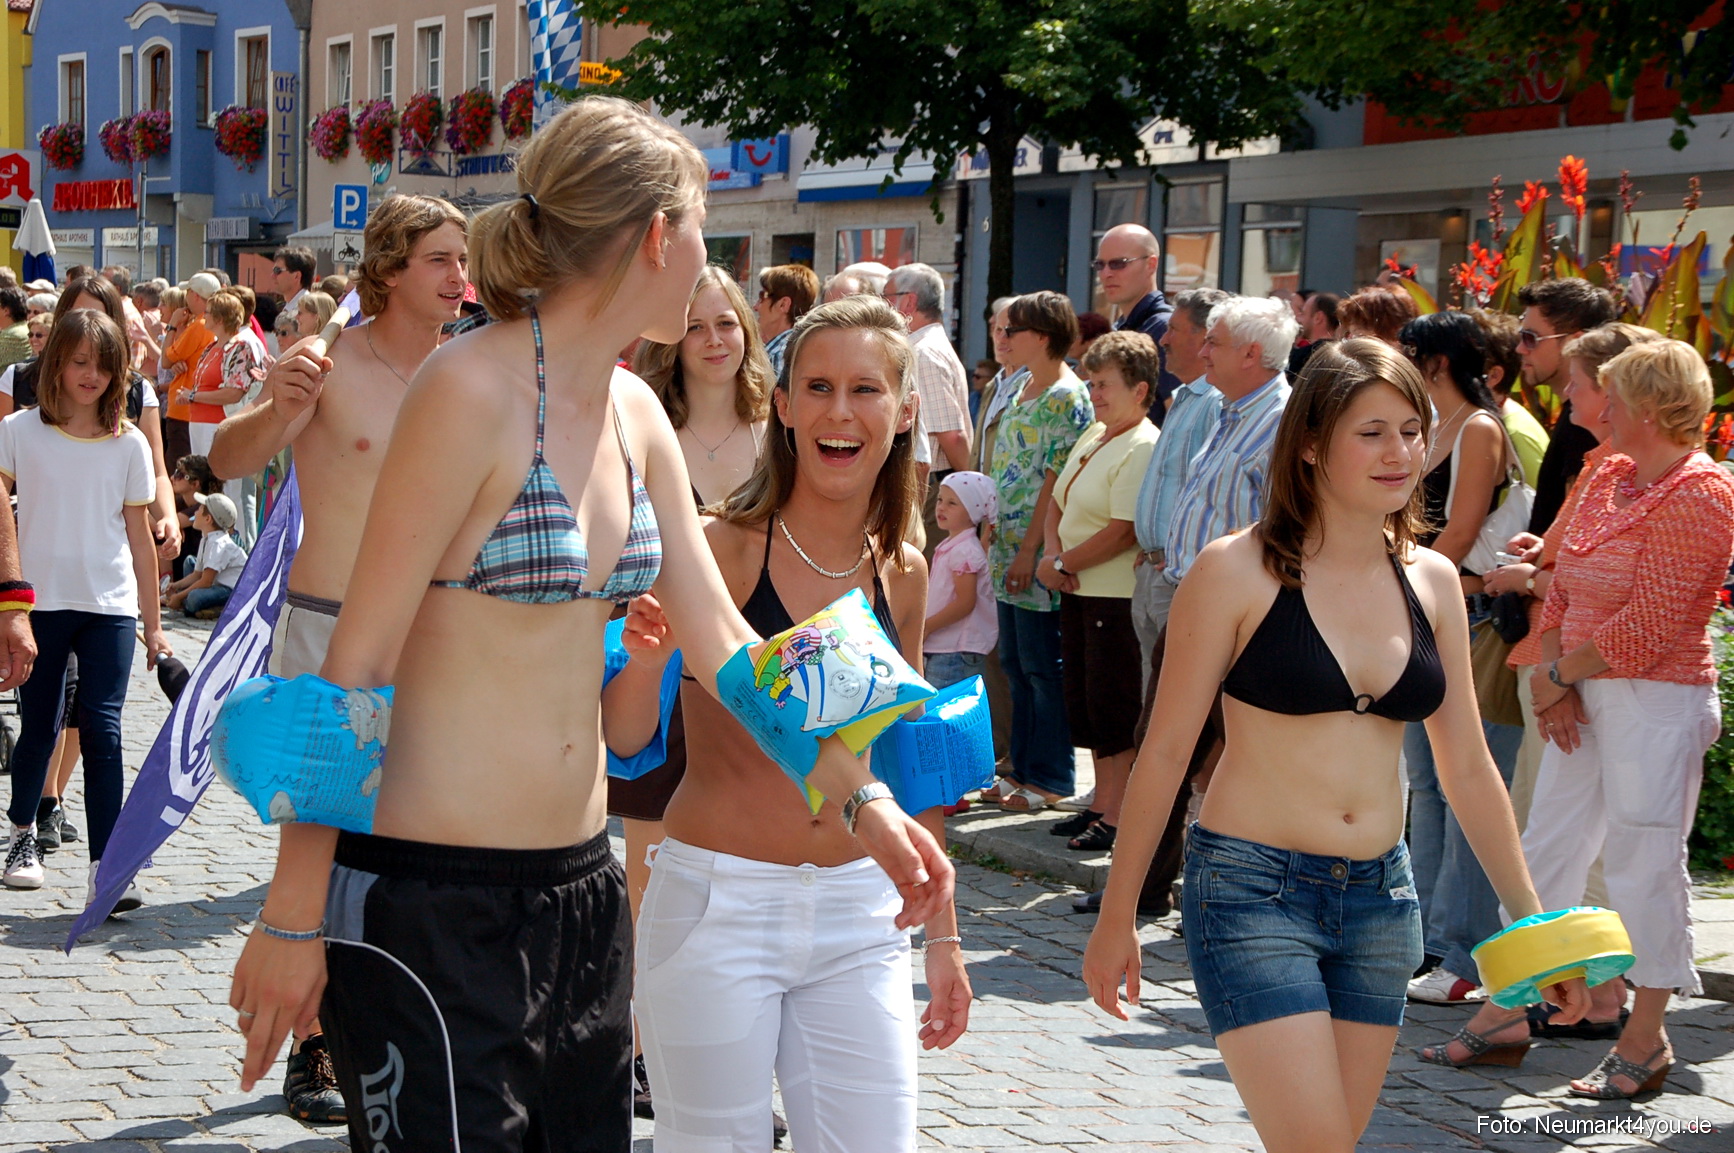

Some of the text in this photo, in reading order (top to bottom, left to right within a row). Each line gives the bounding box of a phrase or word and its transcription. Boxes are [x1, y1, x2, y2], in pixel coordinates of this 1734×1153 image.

[275, 96, 293, 187] WITTL
[53, 179, 133, 211] APOTHEKE
[341, 189, 361, 225] P
